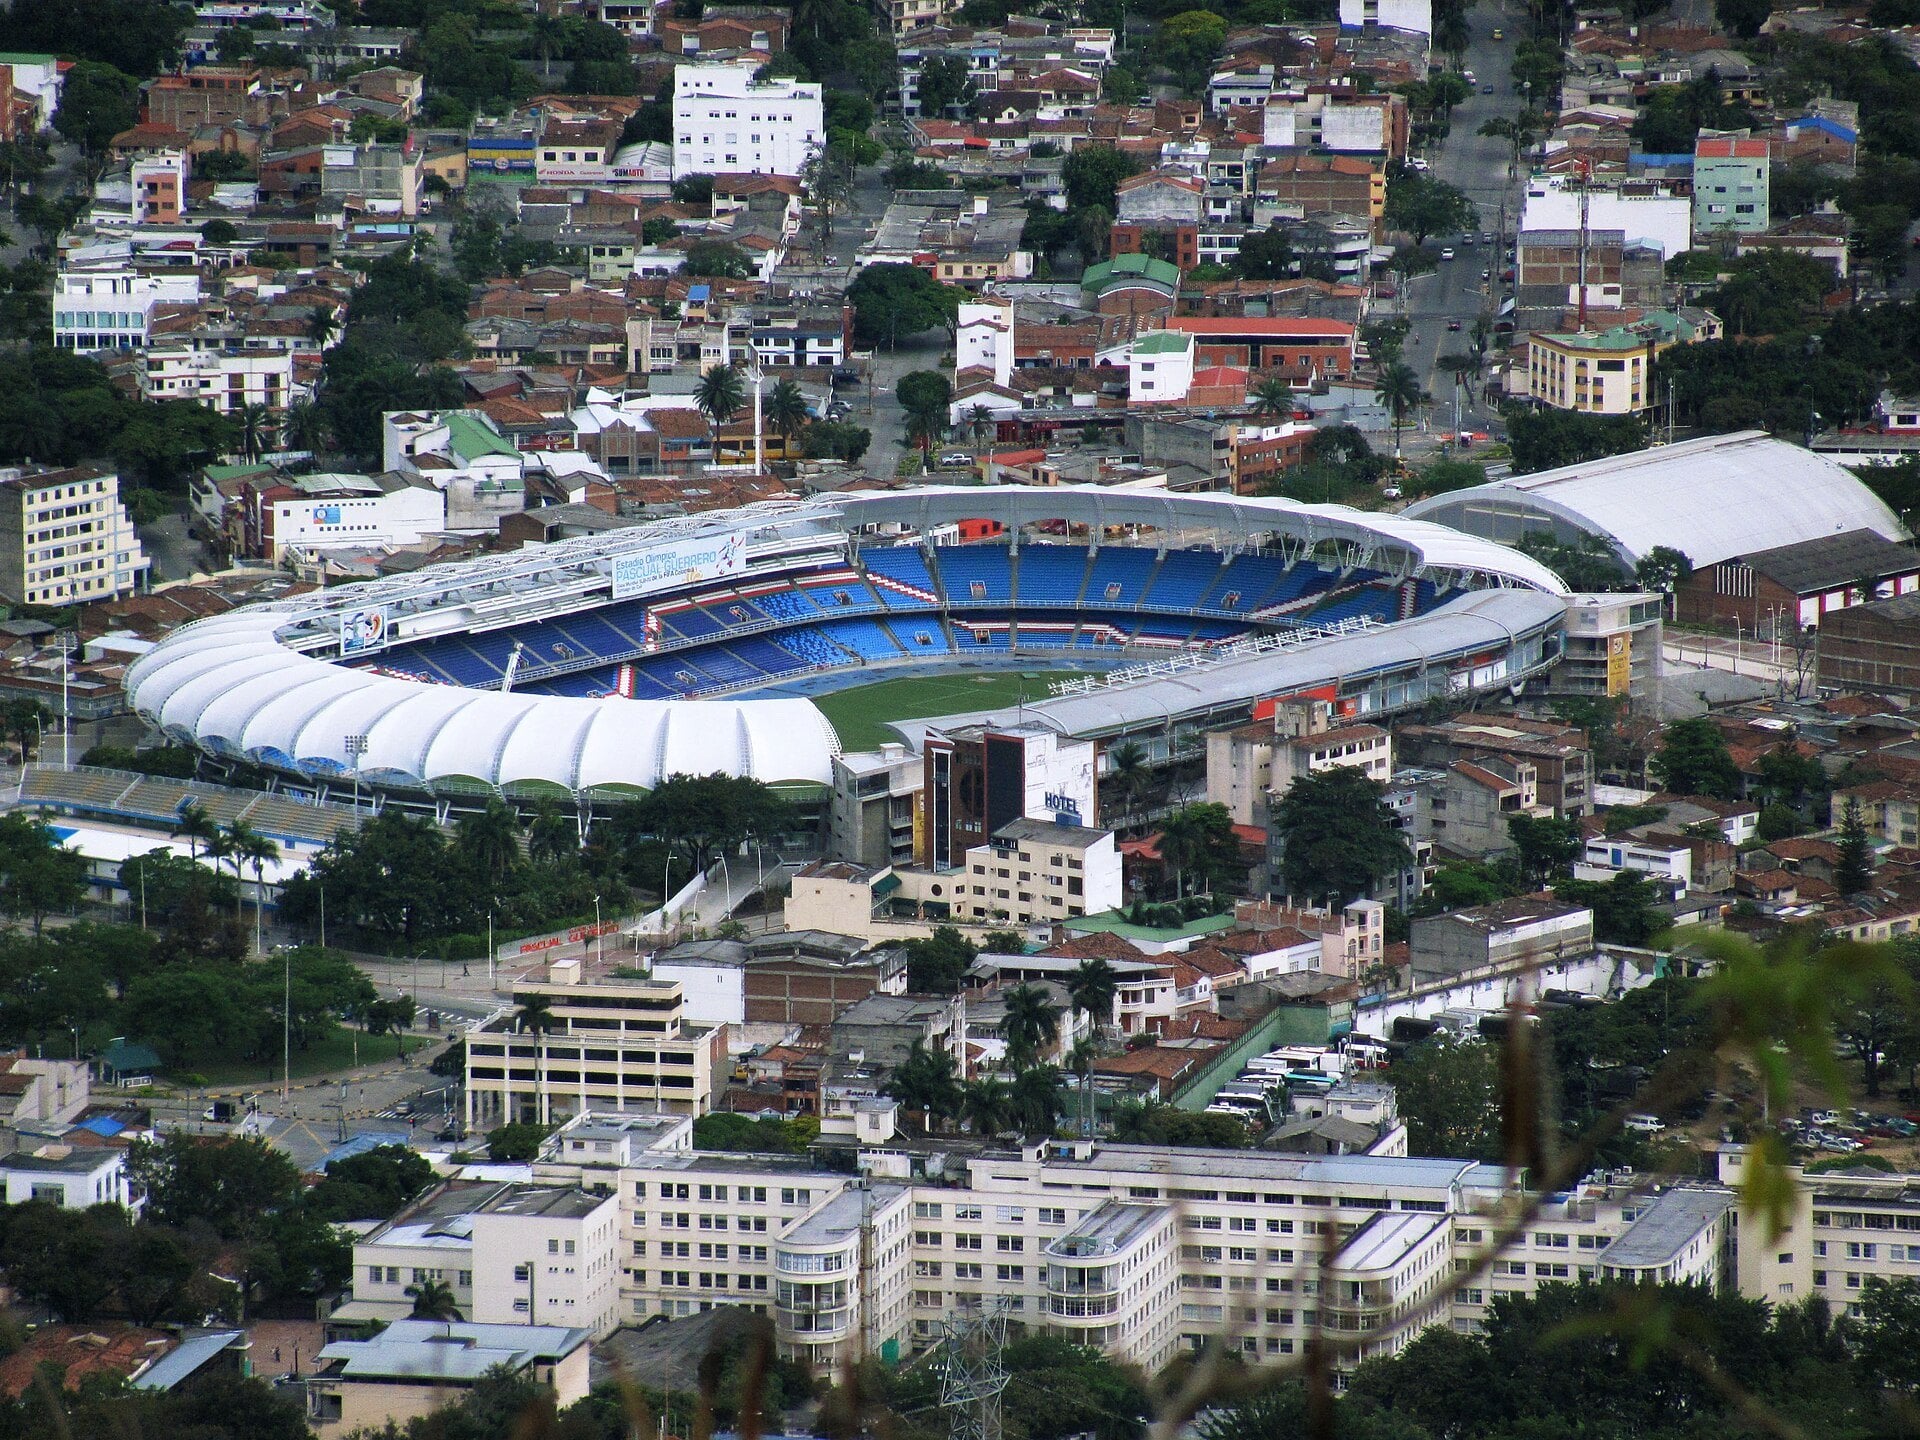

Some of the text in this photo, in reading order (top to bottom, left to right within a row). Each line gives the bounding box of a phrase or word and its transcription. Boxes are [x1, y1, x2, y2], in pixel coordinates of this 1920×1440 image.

[614, 168, 645, 177] SUMAUTO
[615, 556, 644, 571] Estadio
[616, 551, 717, 582] PASCUAL GUERRERO
[1045, 791, 1079, 814] HOTEL
[845, 1089, 874, 1097] Santa
